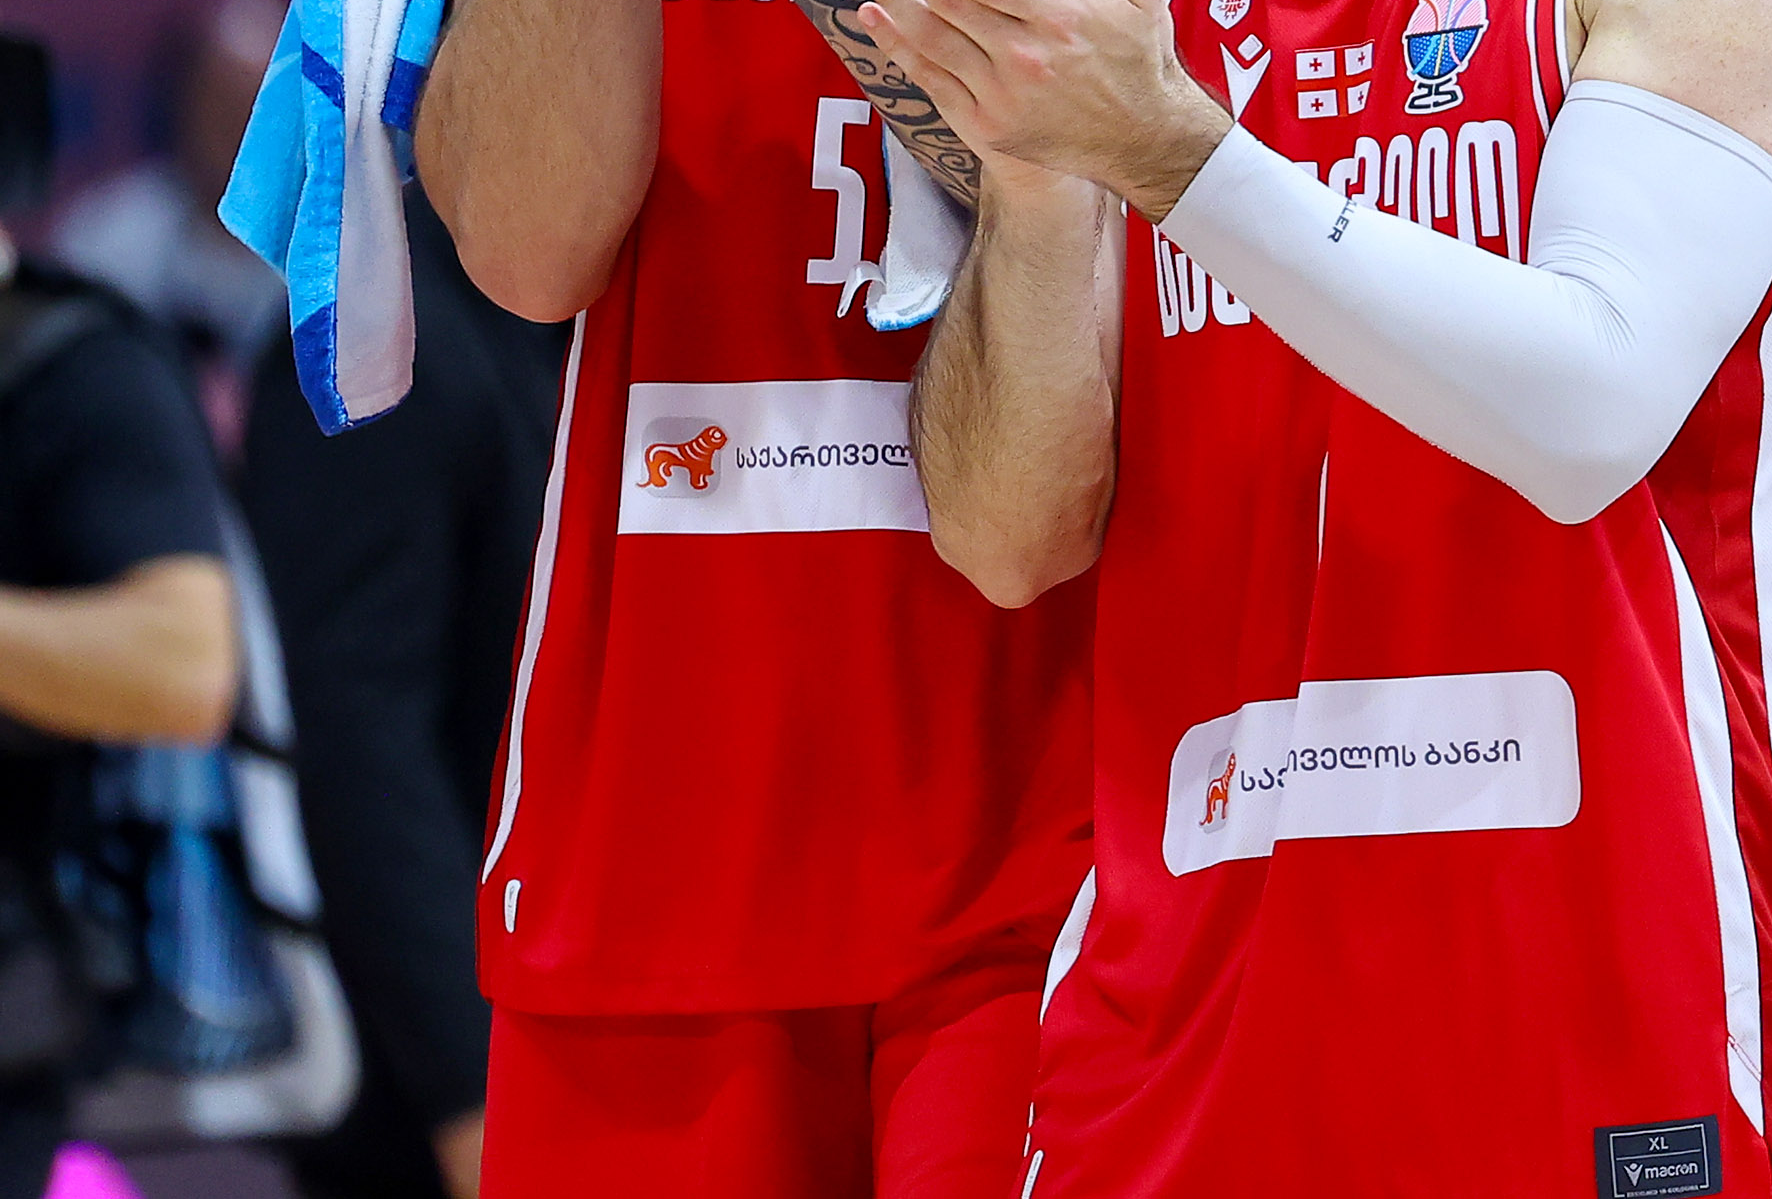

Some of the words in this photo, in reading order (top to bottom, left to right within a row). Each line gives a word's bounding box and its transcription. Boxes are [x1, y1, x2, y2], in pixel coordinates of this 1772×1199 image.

[1408, 77, 1460, 110] 25
[807, 96, 872, 285] 5
[736, 443, 913, 469] საქართველ
[1424, 738, 1521, 766] ბანკი
[1648, 1136, 1669, 1151] XL
[1644, 1162, 1699, 1179] macron
